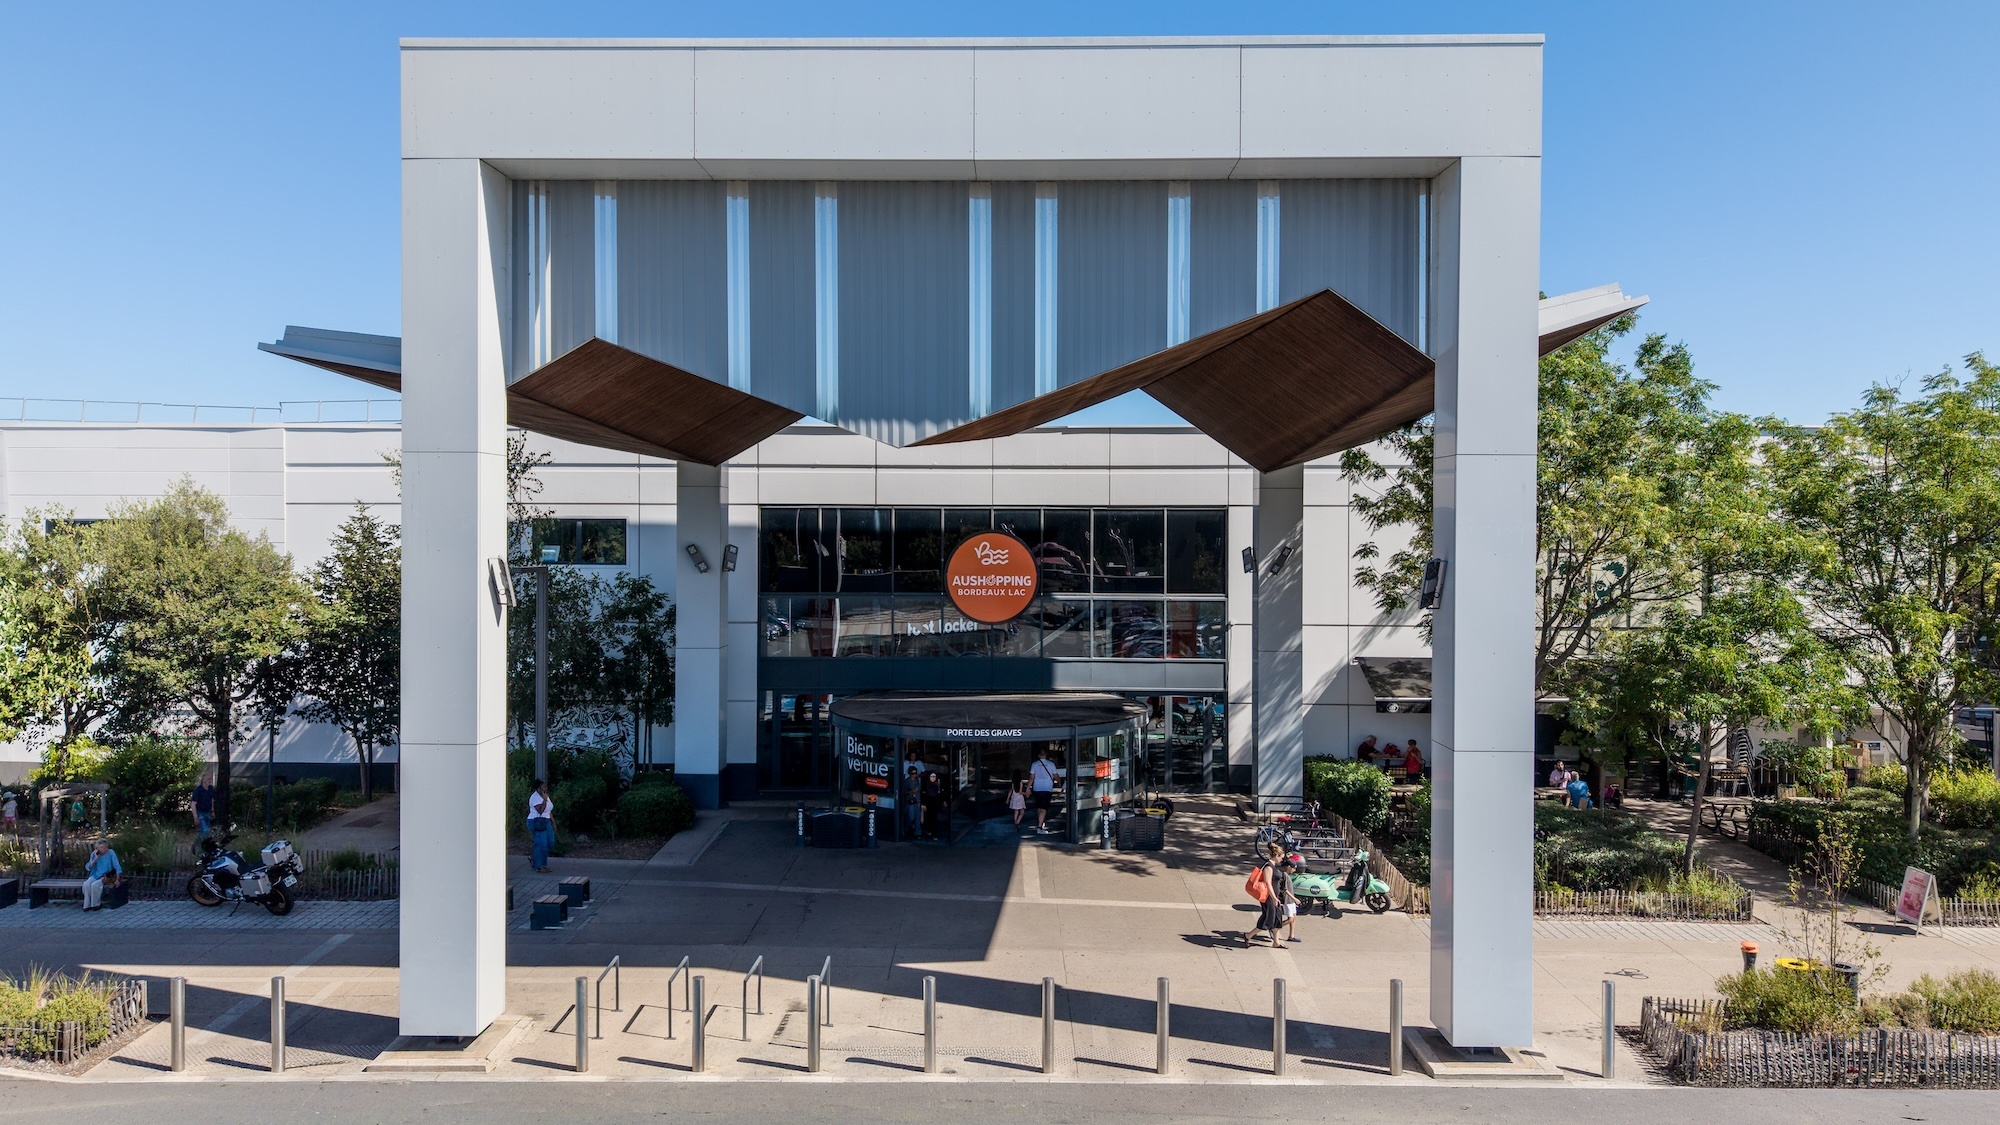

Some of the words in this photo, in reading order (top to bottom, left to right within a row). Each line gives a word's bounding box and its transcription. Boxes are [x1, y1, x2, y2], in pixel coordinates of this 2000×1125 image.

[952, 574, 1032, 587] AUSHOPPING
[957, 588, 1006, 596] BORDEAUX
[1008, 588, 1026, 596] LAC
[947, 728, 973, 737] PORTE
[974, 729, 990, 737] DES
[991, 729, 1022, 737] GRAVES
[847, 735, 874, 758] Bien
[847, 756, 889, 777] venue
